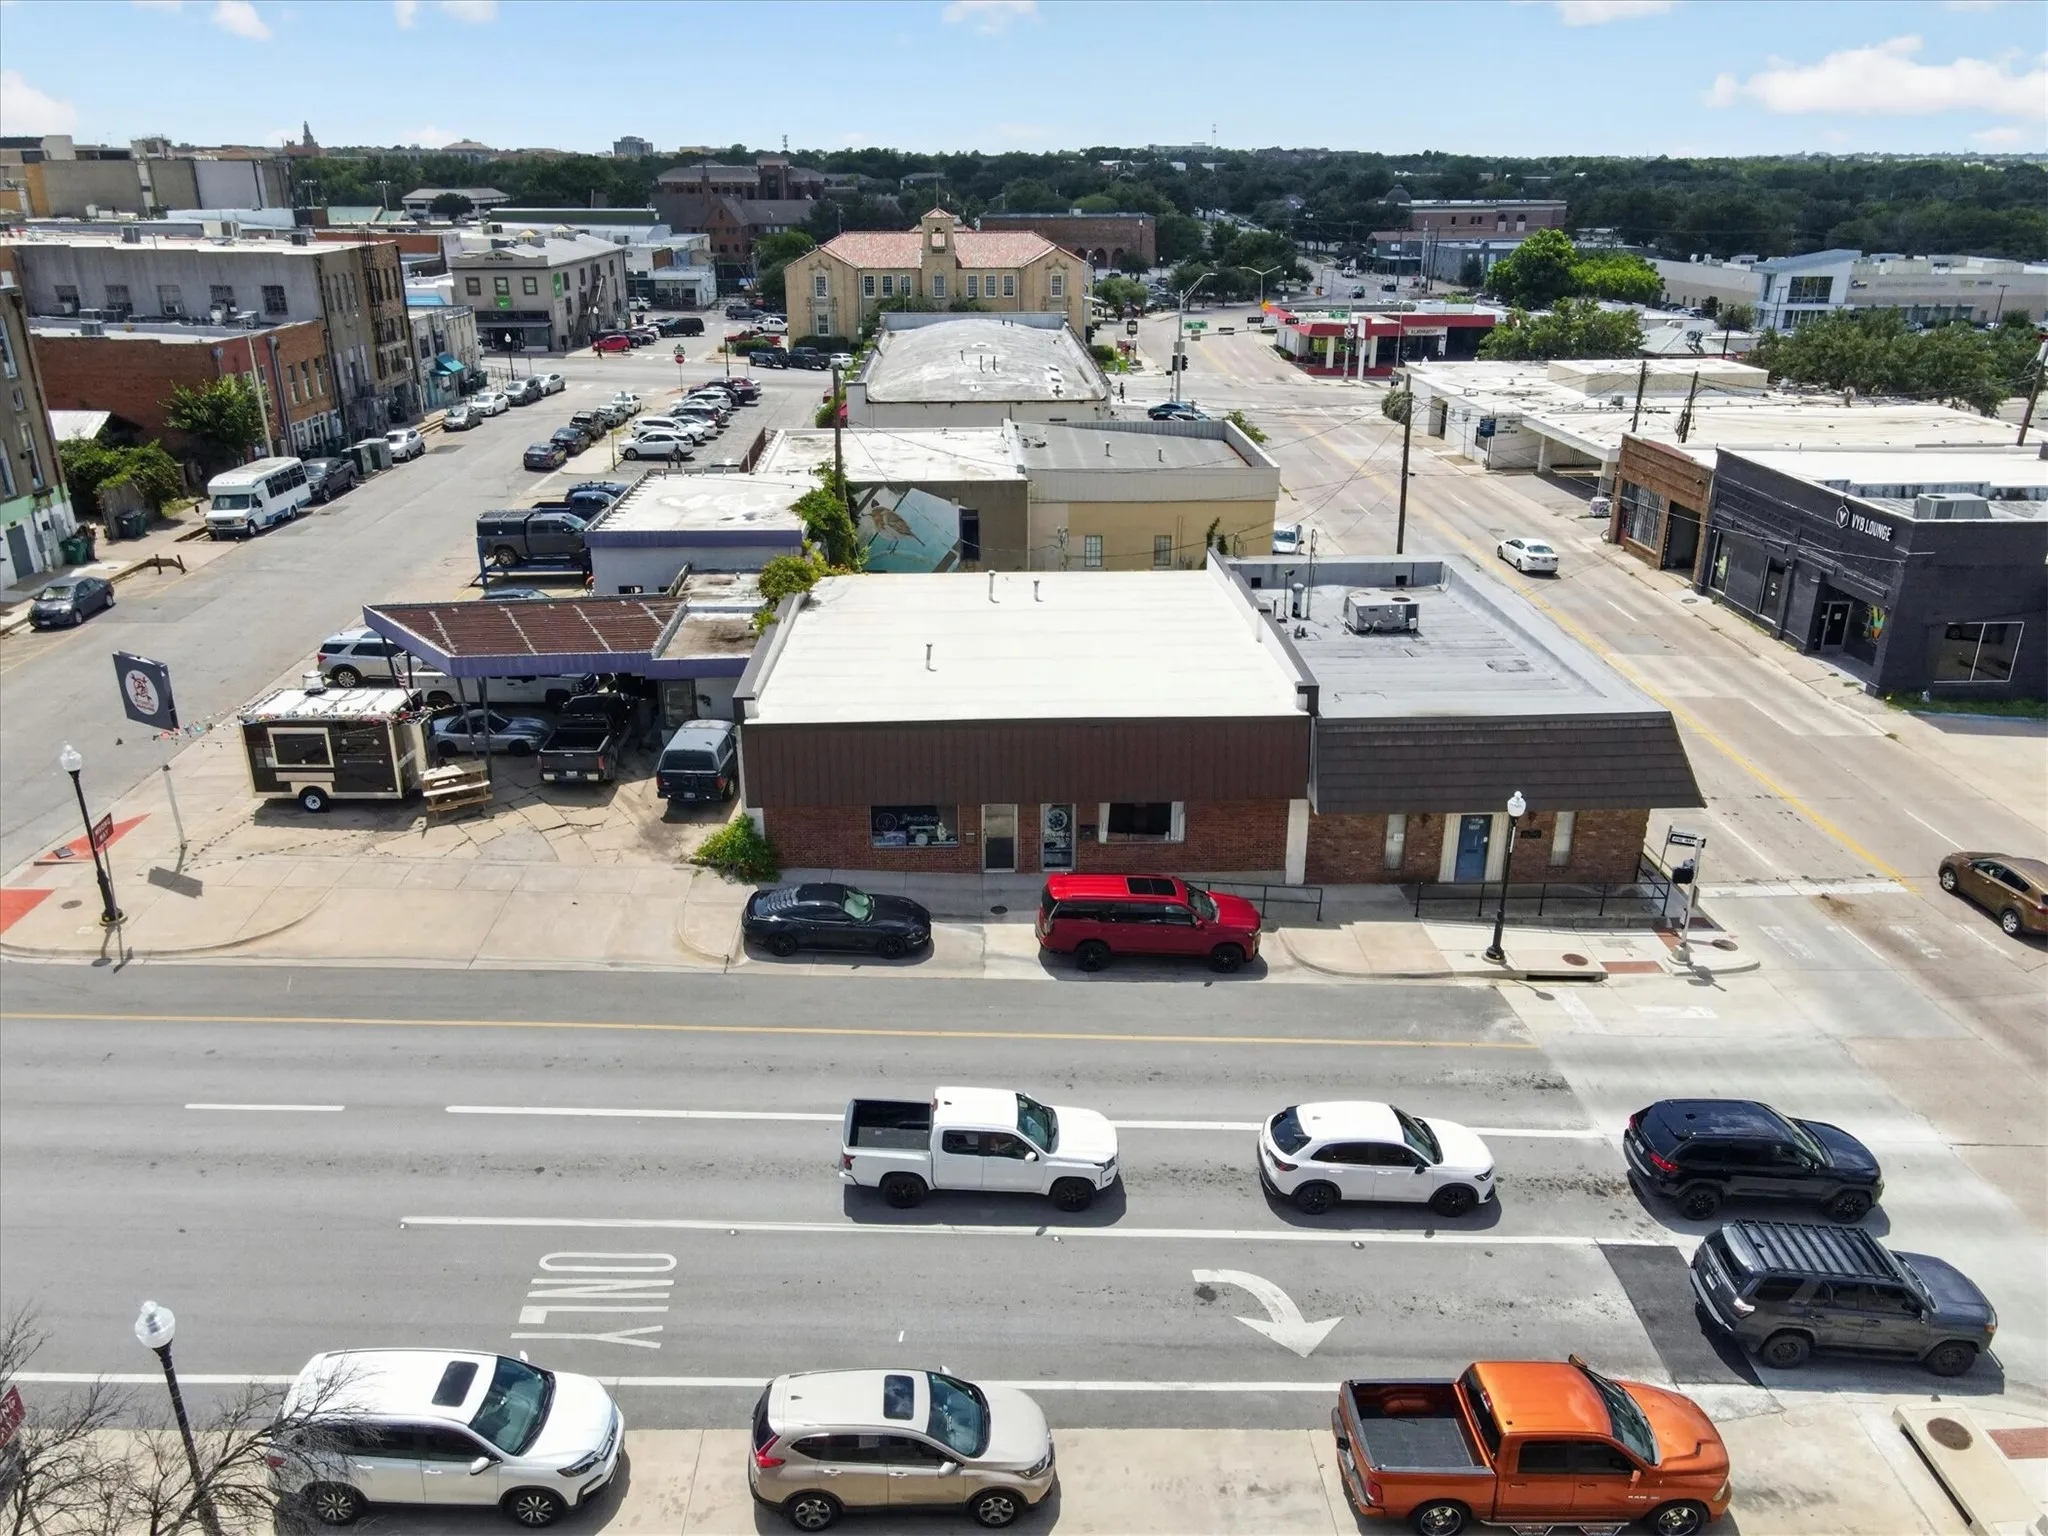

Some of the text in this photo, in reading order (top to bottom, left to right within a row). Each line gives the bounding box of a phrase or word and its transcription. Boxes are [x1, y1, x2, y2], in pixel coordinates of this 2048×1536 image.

[1851, 513, 1892, 542] VYB LOUNGE
[94, 816, 111, 836] WRONG
[98, 828, 109, 842] WAY
[510, 1252, 677, 1348] ONLY
